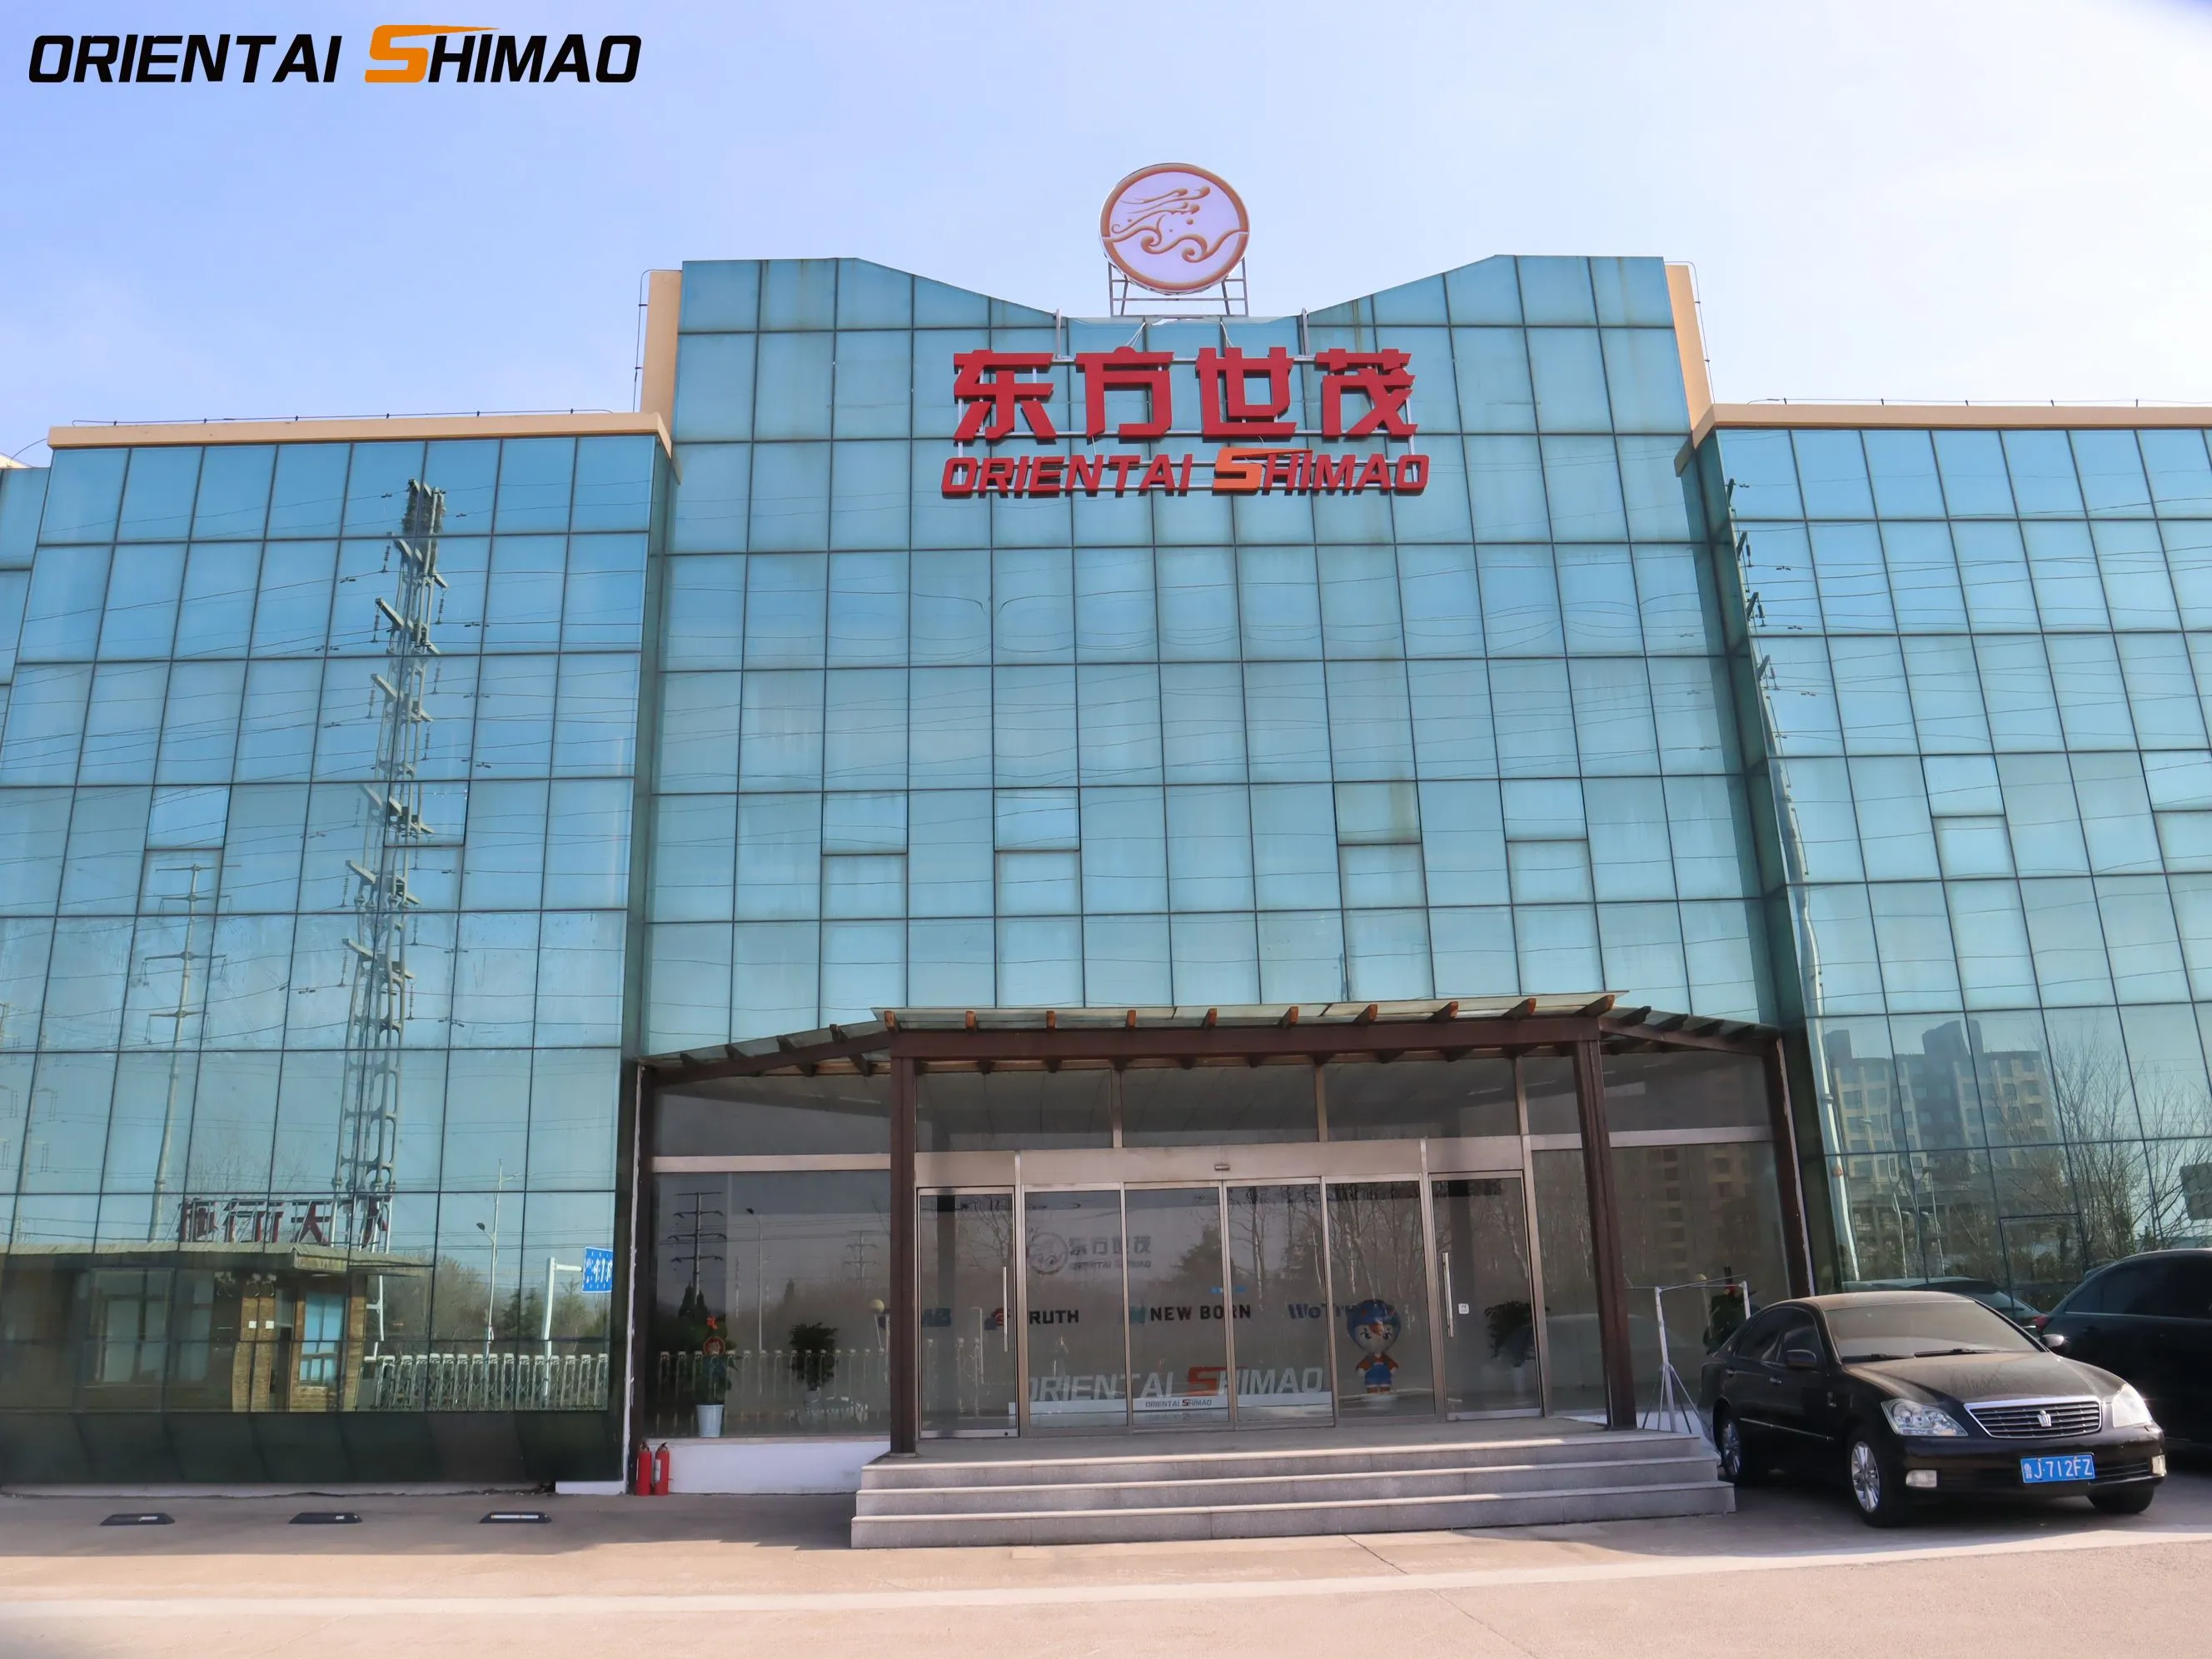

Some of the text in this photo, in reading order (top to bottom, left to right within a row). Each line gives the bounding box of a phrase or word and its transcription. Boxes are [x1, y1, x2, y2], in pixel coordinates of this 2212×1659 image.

[953, 346, 1418, 441] 东方世茂
[1212, 446, 1431, 496] SHIMAO
[1150, 1306, 1192, 1321] NEW
